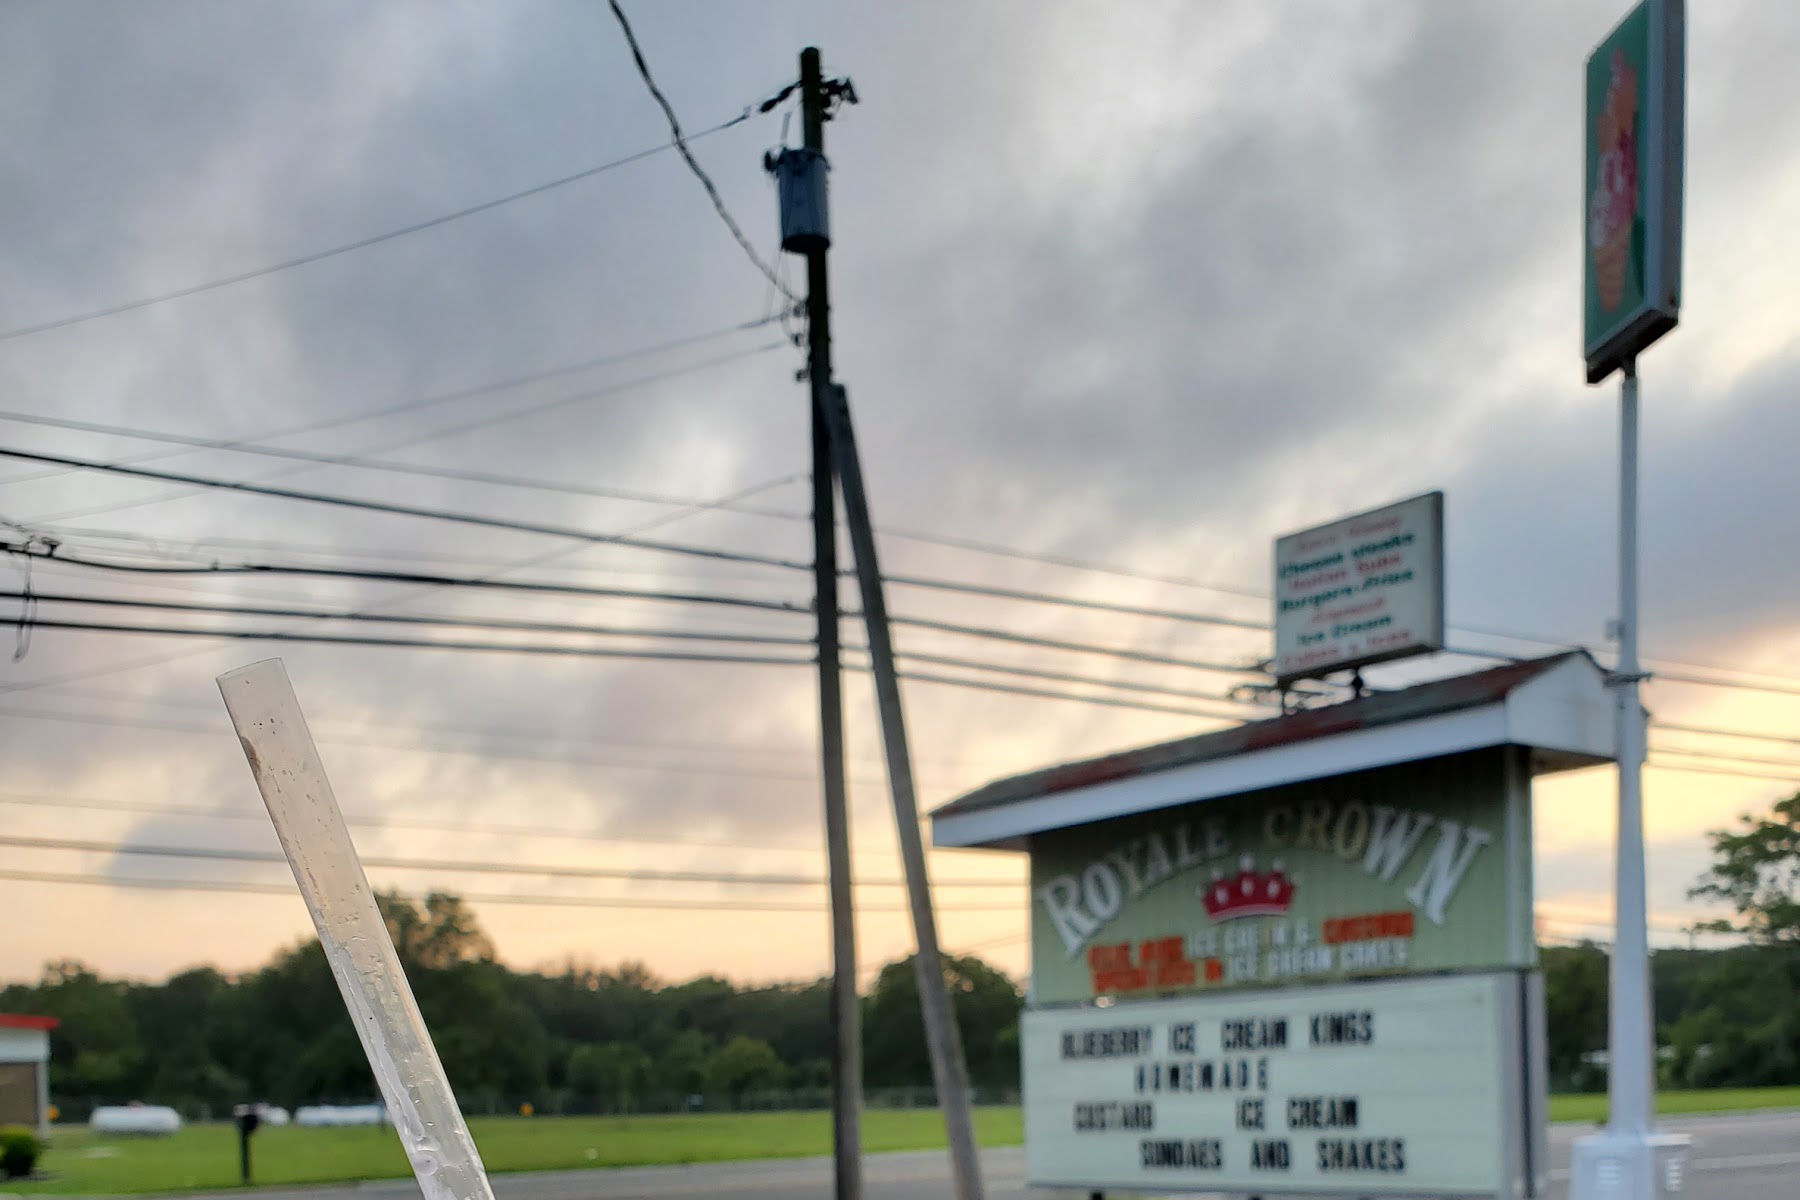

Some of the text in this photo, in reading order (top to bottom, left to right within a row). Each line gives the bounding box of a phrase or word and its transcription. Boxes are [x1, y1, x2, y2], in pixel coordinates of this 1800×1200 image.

[1036, 800, 1491, 956] ROYALE CROWN
[1169, 1021, 1195, 1053] ICE
[1222, 1016, 1288, 1050] CREAM
[1310, 1009, 1374, 1045] KINGS
[1135, 1057, 1267, 1093] HOMEMADE
[1073, 1096, 1358, 1132] CUSTARD ICE CREAM
[1139, 1138, 1405, 1172] SUNDAES AND SHAKES
